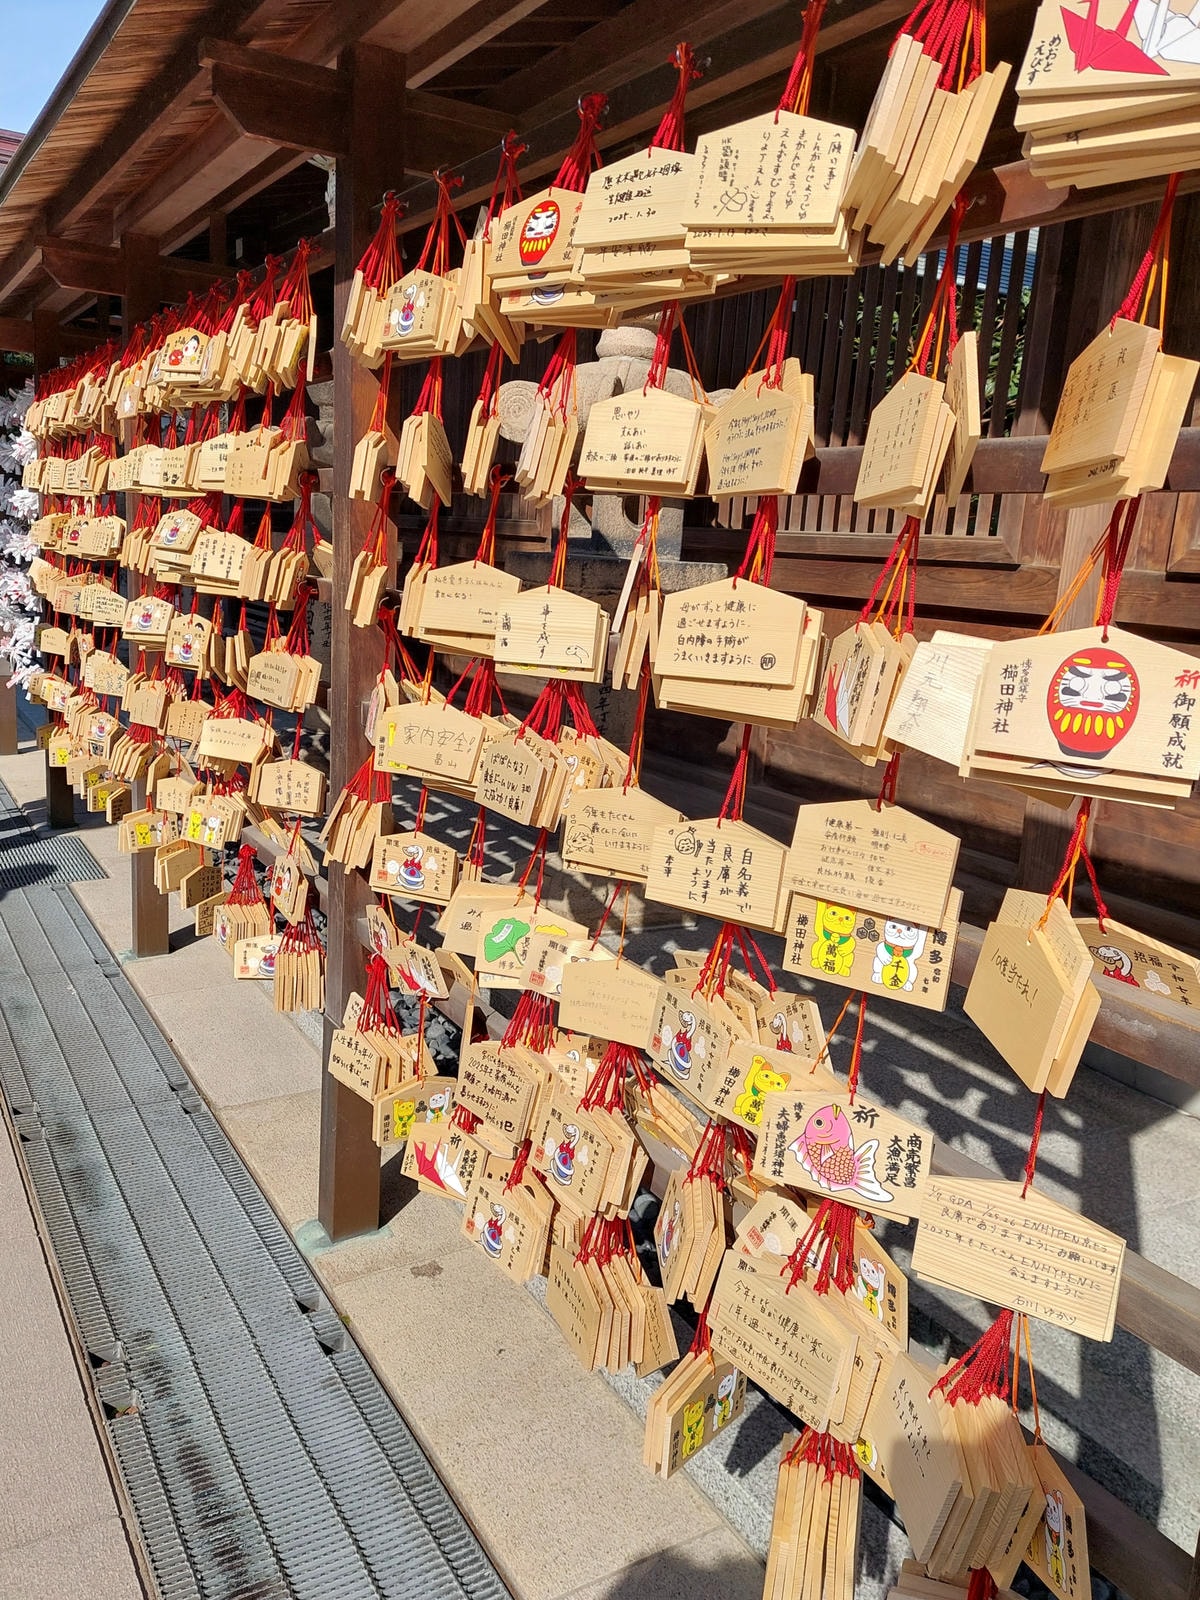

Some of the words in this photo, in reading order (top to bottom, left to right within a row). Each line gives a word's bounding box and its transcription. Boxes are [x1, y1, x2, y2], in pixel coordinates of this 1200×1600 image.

[1026, 40, 1046, 86] えびす
[1043, 33, 1061, 72] めおと
[680, 600, 757, 613] 母がずっと健康に
[677, 635, 750, 649] 白内障の手術が
[991, 664, 1018, 734] 櫛田神社
[403, 722, 476, 753] 家内安全!
[701, 839, 716, 903] 当たります
[717, 844, 733, 896] 良席が
[736, 848, 753, 913] 自名義で
[548, 940, 568, 954] 開運
[790, 913, 809, 965] 櫛田神社
[929, 930, 948, 965] 博多
[823, 943, 838, 972] 萬福
[1133, 950, 1164, 968] 招福
[888, 960, 904, 988] 千金
[713, 1066, 741, 1108] 櫛田神社
[793, 1102, 805, 1122] 博多
[852, 1105, 880, 1129] 祈
[450, 1133, 462, 1149] 祈
[882, 1135, 907, 1188] 大漁満足
[949, 1194, 973, 1210] GDA
